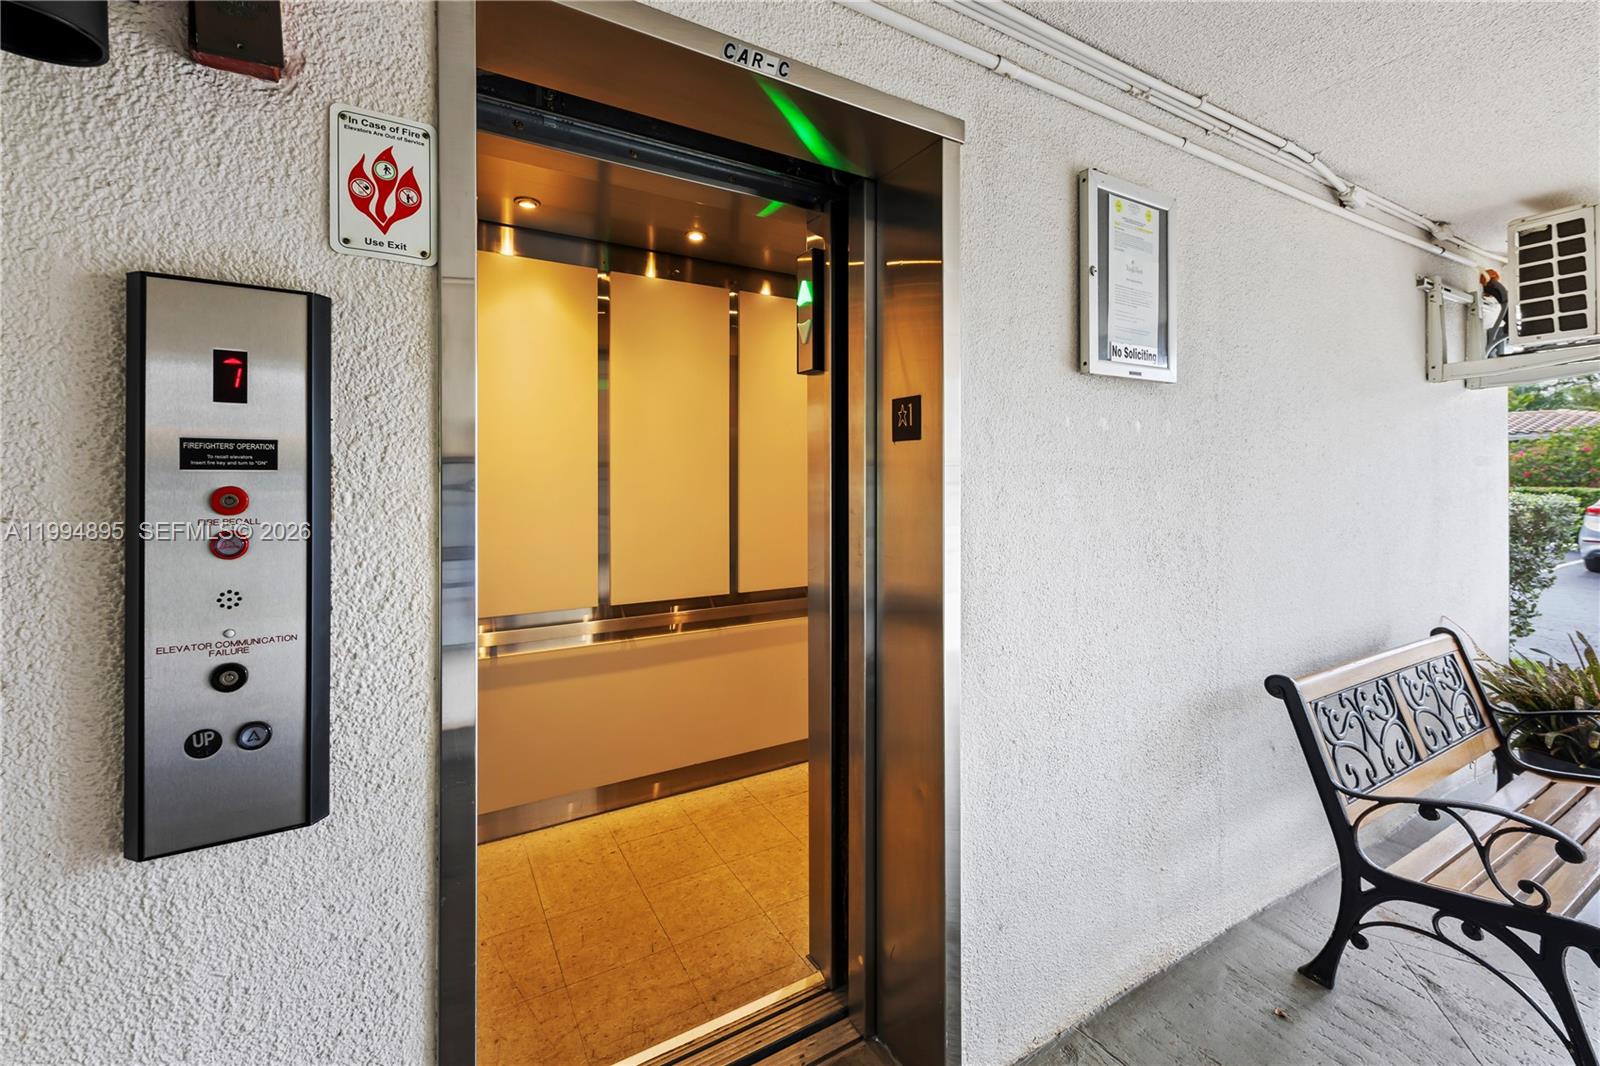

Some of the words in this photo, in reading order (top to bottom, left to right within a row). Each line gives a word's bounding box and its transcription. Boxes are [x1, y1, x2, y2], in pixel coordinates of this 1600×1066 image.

[724, 42, 790, 77] CAR-C
[344, 124, 372, 135] Elevators
[404, 137, 425, 147] Service
[348, 116, 358, 125] In
[361, 119, 386, 131] Case
[389, 126, 400, 134] of
[402, 128, 421, 139] Fire
[365, 237, 385, 247] Use
[387, 240, 407, 251] Exit
[1112, 345, 1122, 358] No
[1124, 346, 1157, 365] Soliciting
[183, 442, 235, 450] FIREFIGHTERS'
[155, 642, 213, 655] ELEVATOR
[215, 634, 298, 649] COMMUNICATION
[208, 646, 250, 658] FAILURE
[192, 731, 215, 748] UP
